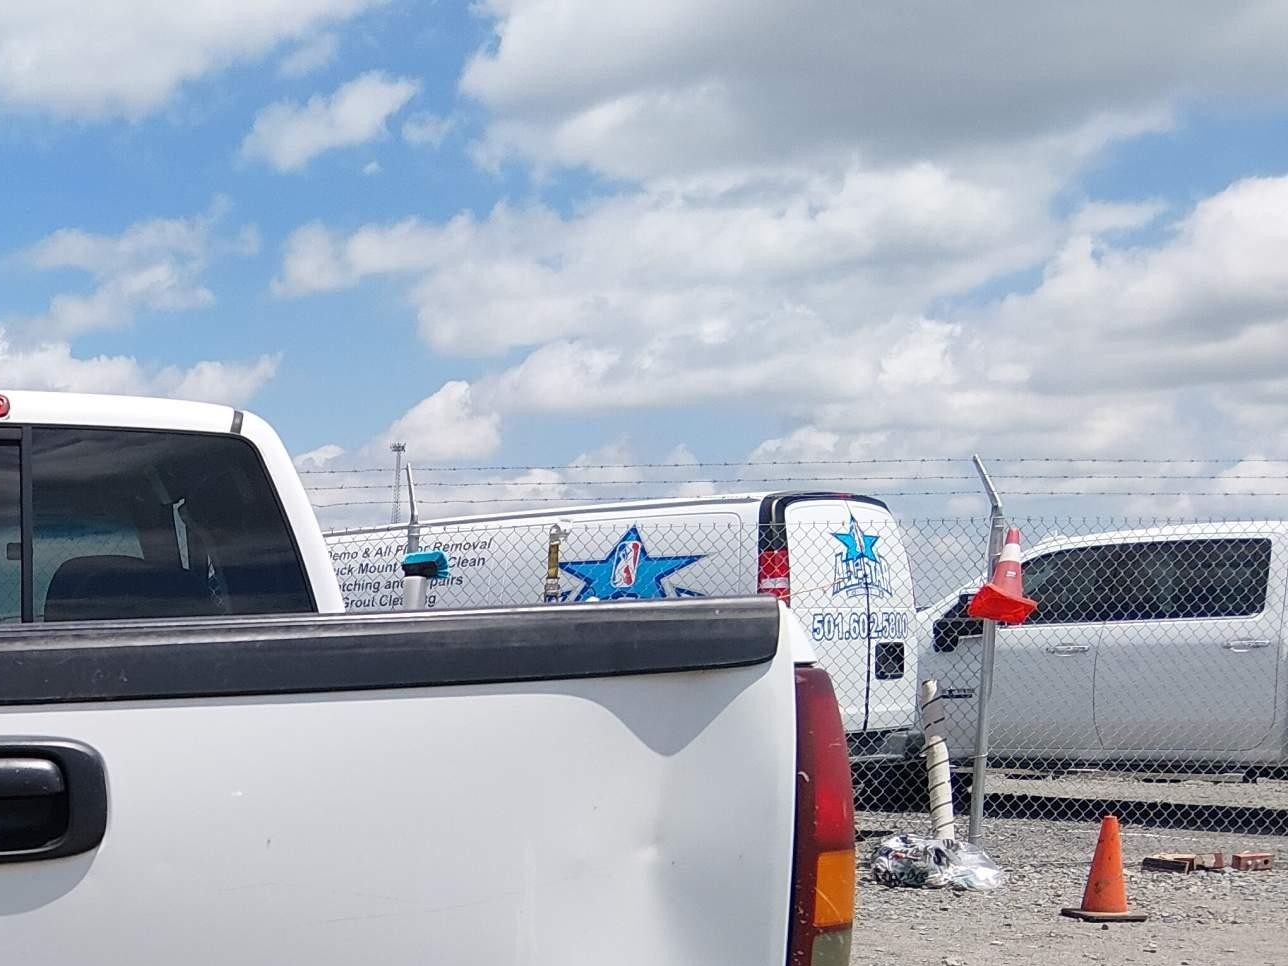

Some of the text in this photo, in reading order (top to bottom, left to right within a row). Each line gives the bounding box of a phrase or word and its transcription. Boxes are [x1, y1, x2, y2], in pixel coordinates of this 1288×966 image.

[362, 548, 370, 559] &
[374, 544, 392, 558] All
[394, 543, 430, 556] Flor
[433, 537, 493, 552] Removal
[333, 556, 486, 576] uck Mount Clean
[339, 579, 381, 593] tching
[429, 575, 463, 590] pairs
[813, 611, 908, 641] 501.602.5800
